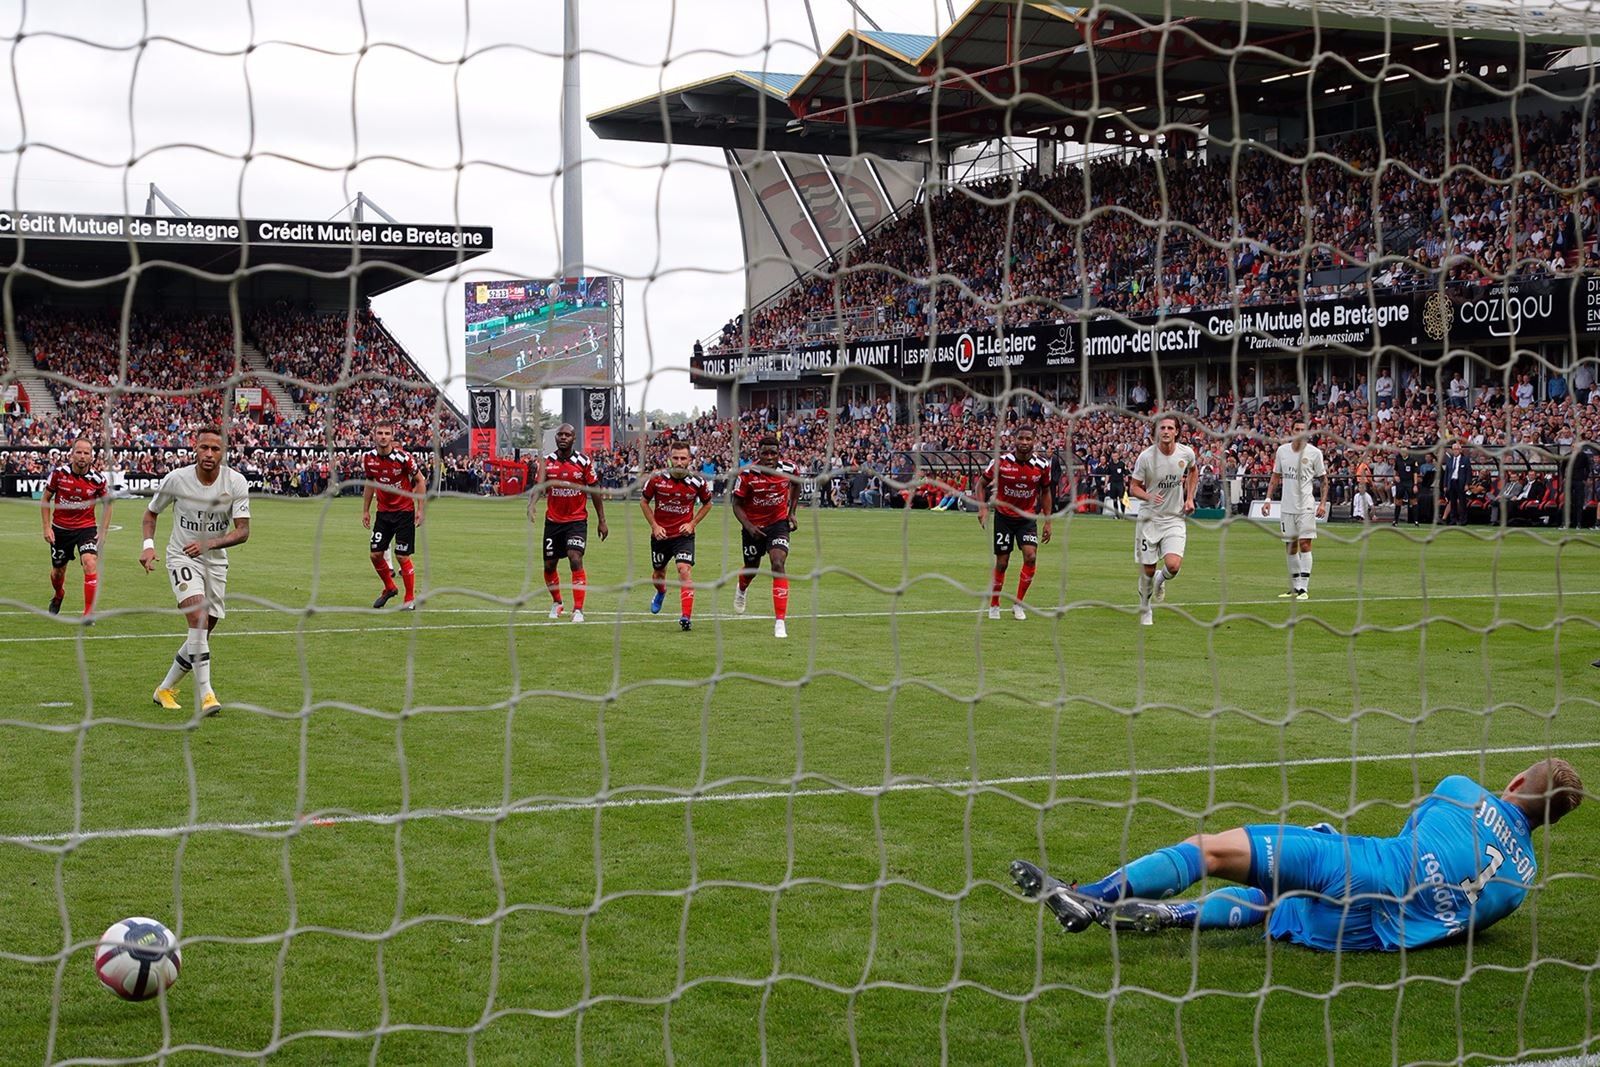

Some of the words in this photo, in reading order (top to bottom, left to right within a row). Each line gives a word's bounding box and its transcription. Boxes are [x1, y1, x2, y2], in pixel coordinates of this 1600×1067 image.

[0, 213, 55, 233] Crédit
[60, 216, 124, 236] Mutuel
[129, 219, 152, 237] de
[156, 220, 240, 242] Bretagne
[258, 222, 314, 241] Crédit
[318, 224, 377, 242] Mutuel
[380, 227, 403, 243] de
[406, 228, 483, 247] Bretagne
[1256, 309, 1306, 331] Mutuel
[1310, 307, 1331, 327] de
[1333, 303, 1409, 328] Bretagne
[904, 349, 919, 364] LES
[920, 348, 937, 363] PRX
[938, 346, 954, 362] BAS
[976, 333, 1036, 355] E.Leclerc
[703, 358, 726, 376] TOUS
[855, 345, 890, 366] AVANT
[894, 344, 898, 363] !
[545, 538, 553, 550] 2
[996, 532, 1011, 545] 24
[1141, 539, 1148, 552] 5
[172, 566, 193, 586] 10
[1475, 800, 1537, 886] JOHNSSON
[1460, 844, 1505, 905] 1
